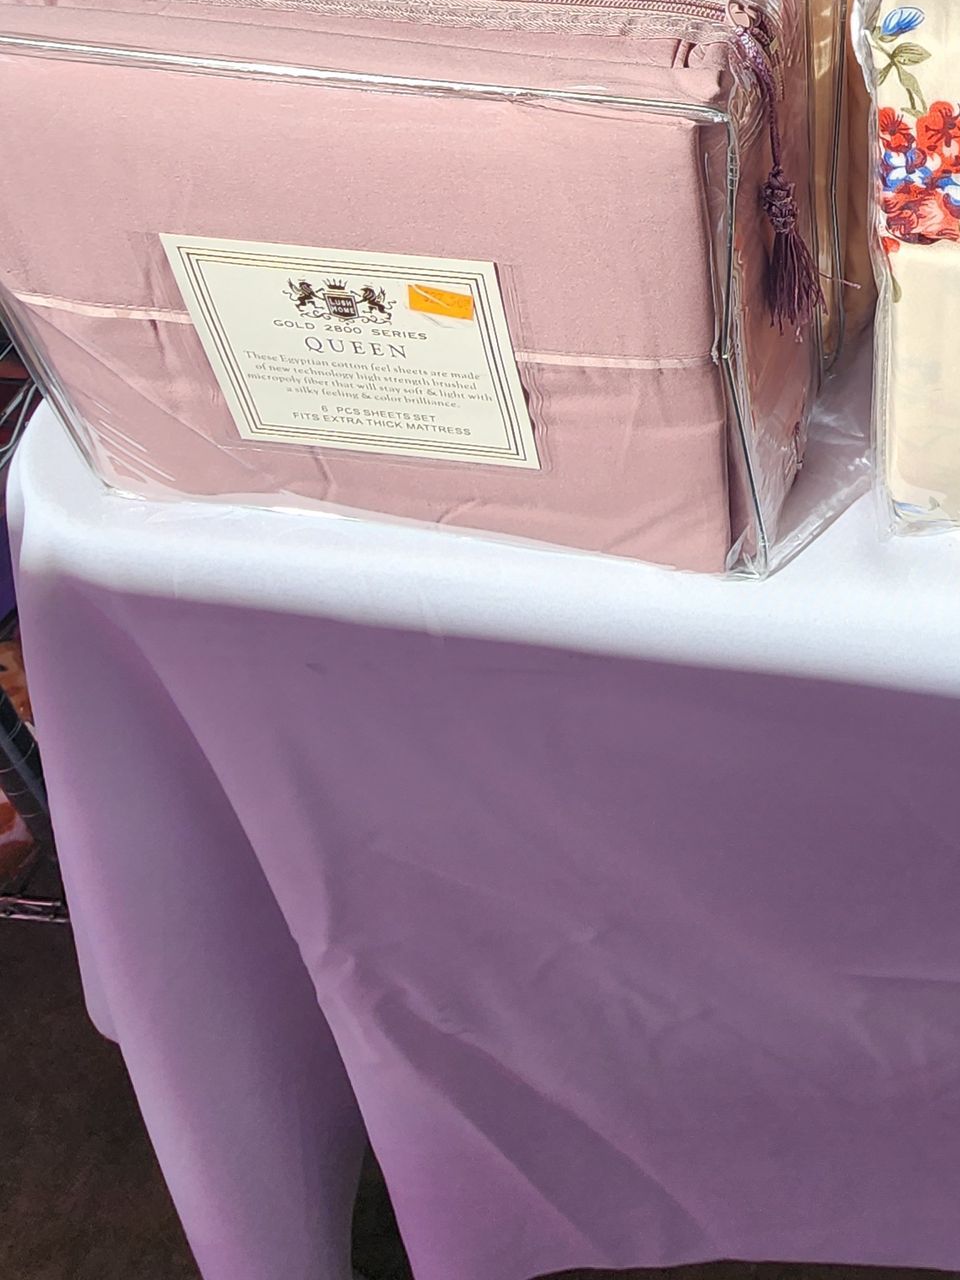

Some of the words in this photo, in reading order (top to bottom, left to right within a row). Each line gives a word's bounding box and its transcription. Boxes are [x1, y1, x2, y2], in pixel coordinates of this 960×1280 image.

[273, 319, 315, 330] GOLD
[324, 324, 362, 335] 2800
[371, 328, 427, 340] SERIES
[305, 336, 406, 359] QUEEN
[244, 351, 278, 362] These
[280, 354, 329, 367] Egyptian
[331, 361, 368, 371] cotton
[370, 362, 391, 372] feel
[393, 365, 428, 376] sheets
[451, 372, 481, 380] made
[247, 373, 301, 385] micropoly
[304, 376, 329, 386] fiber
[331, 380, 354, 389] that
[356, 382, 377, 391] will
[379, 386, 401, 395] stay
[403, 387, 423, 395] soft
[439, 389, 465, 400] light
[467, 393, 493, 402] with
[293, 367, 354, 380] technology
[355, 371, 381, 382] high
[384, 375, 430, 386] strength
[432, 378, 477, 390] brushed
[295, 386, 319, 396] silky
[322, 388, 359, 400] feeling
[374, 394, 402, 403] color
[292, 412, 320, 421] FITS
[323, 414, 364, 425] EXTRA
[366, 419, 402, 429] THICK
[406, 422, 471, 436] MATTRESS
[336, 406, 361, 415] PCS
[363, 409, 411, 420] SHEETS
[413, 413, 436, 422] SET
